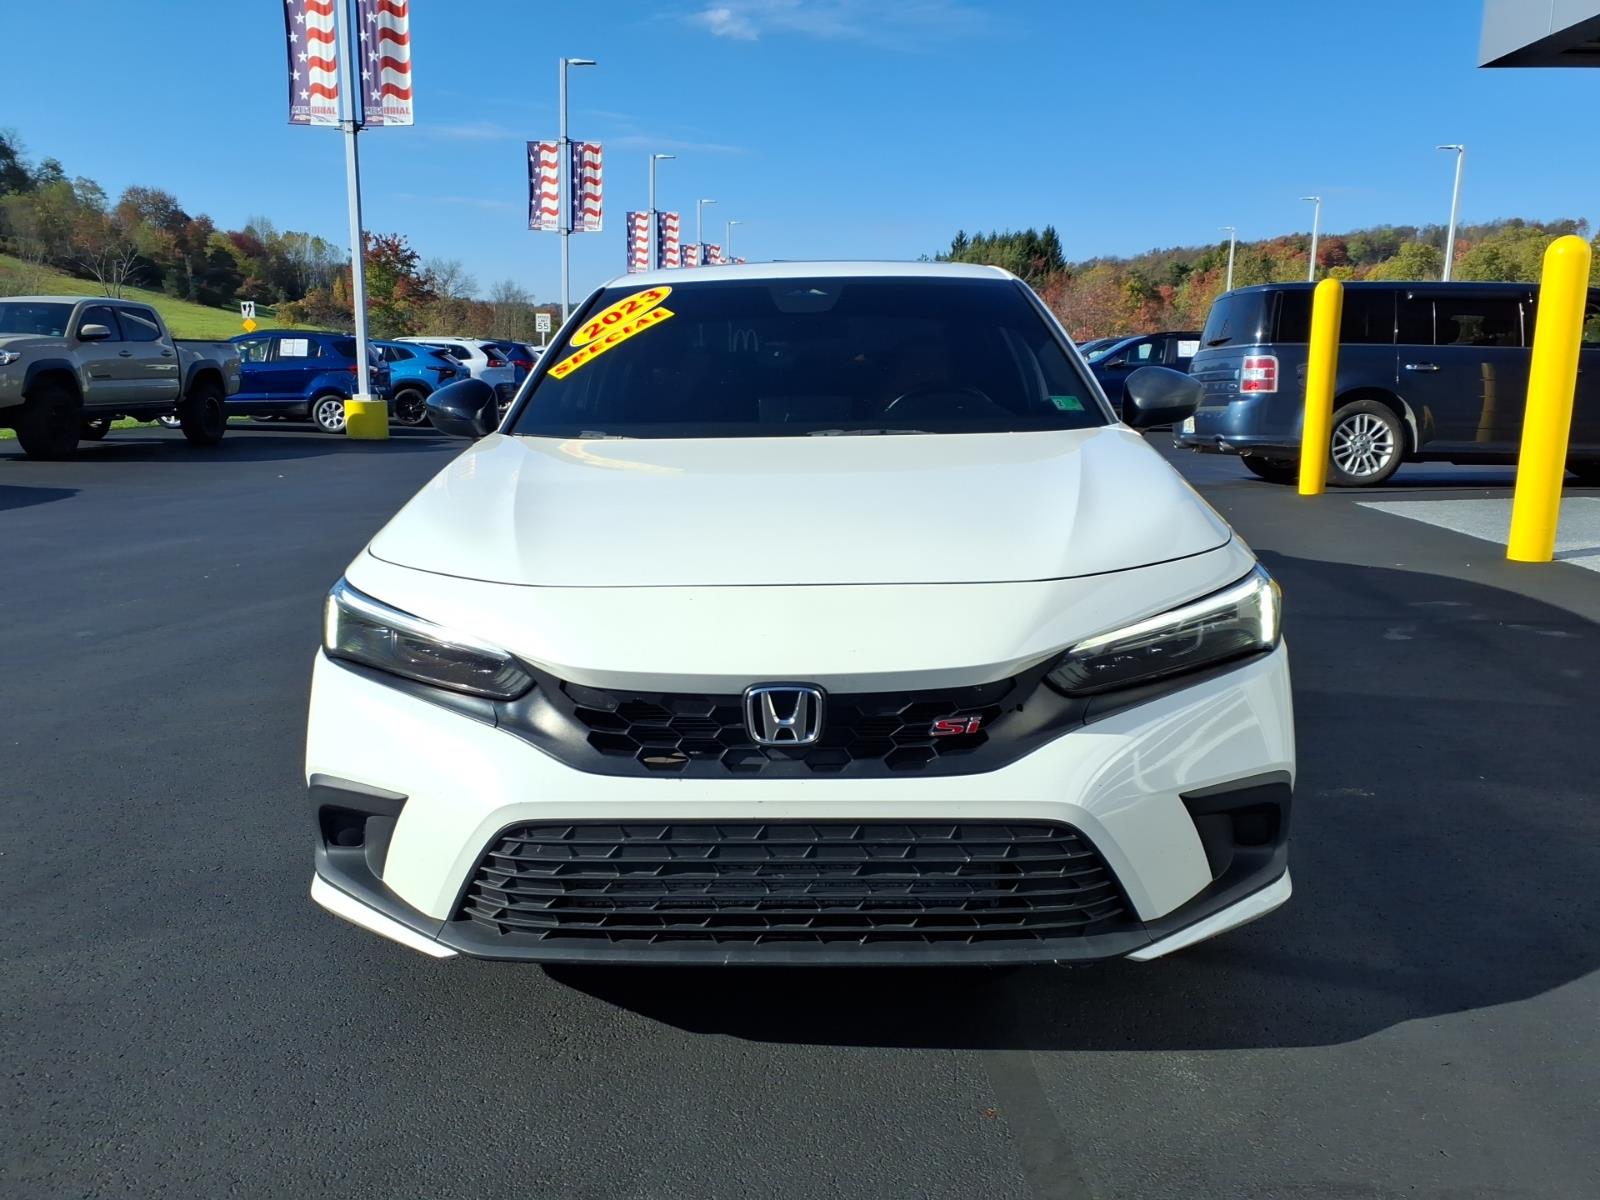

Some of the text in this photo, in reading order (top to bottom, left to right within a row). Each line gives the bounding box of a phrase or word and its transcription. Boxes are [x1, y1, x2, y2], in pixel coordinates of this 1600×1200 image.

[537, 322, 549, 330] 55
[583, 290, 661, 340] 2023
[555, 311, 670, 375] SPECIAL
[928, 715, 982, 737] Si
